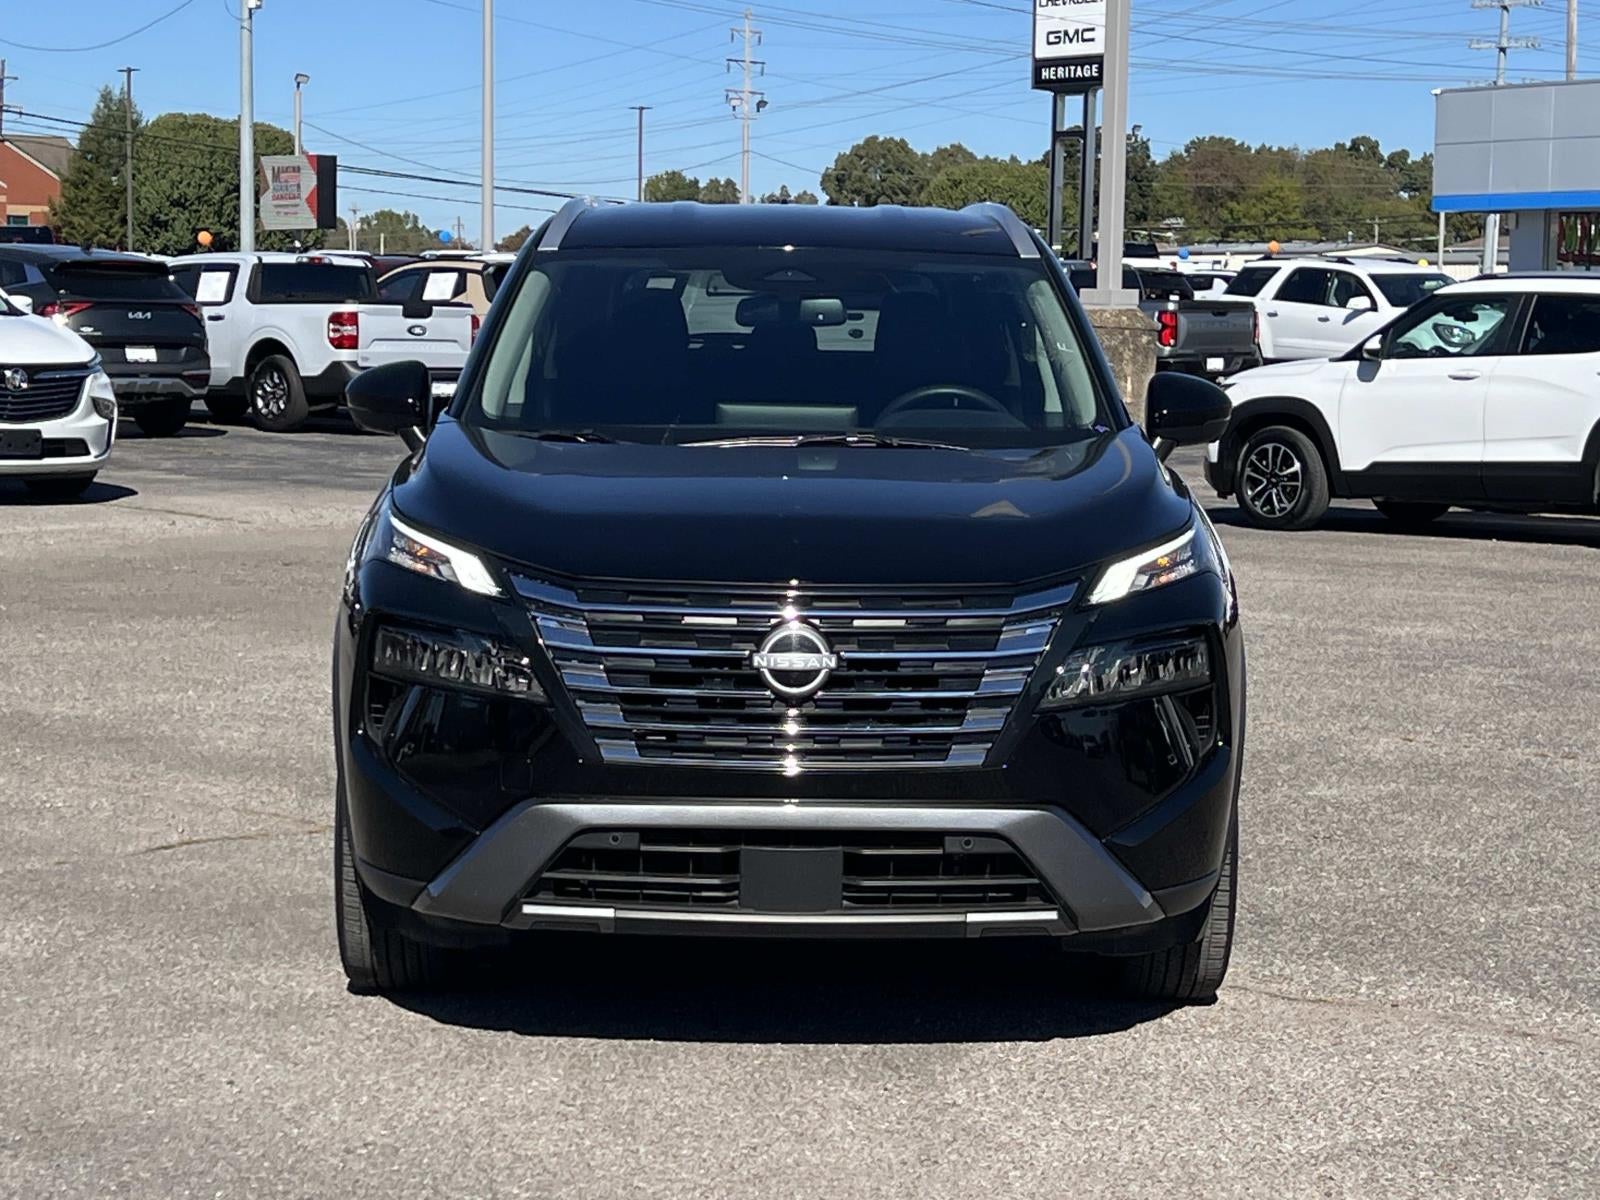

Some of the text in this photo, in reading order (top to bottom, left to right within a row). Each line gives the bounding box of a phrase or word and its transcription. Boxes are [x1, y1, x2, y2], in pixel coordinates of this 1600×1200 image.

[1039, 0, 1103, 8] CHEVR
[1046, 27, 1095, 45] GMC
[1041, 64, 1099, 79] HERITAGE
[753, 656, 837, 668] NISSAN
